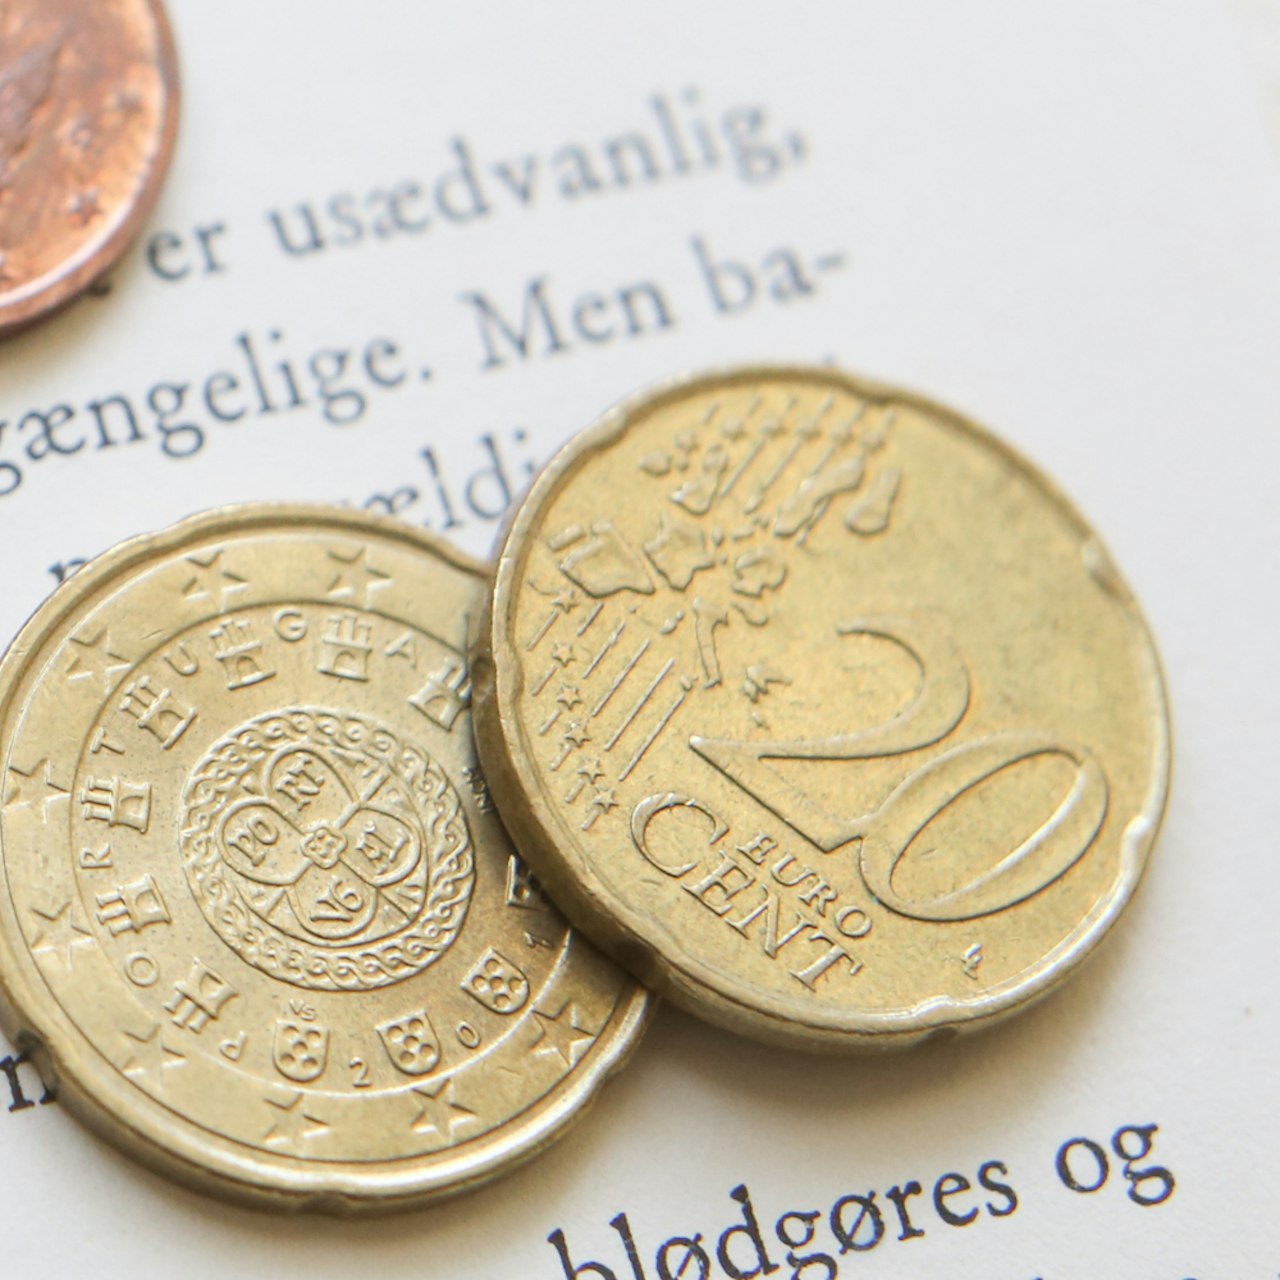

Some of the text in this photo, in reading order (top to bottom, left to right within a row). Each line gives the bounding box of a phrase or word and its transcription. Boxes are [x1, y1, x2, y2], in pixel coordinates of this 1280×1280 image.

[146, 220, 230, 283] er
[267, 87, 809, 258] usædvanlig,
[462, 276, 677, 370] Men
[688, 236, 848, 315] ba-
[689, 614, 1110, 924] 20
[628, 790, 864, 993] CENT
[735, 830, 875, 940] EURO
[547, 1122, 1177, 1280] blødgøres og
